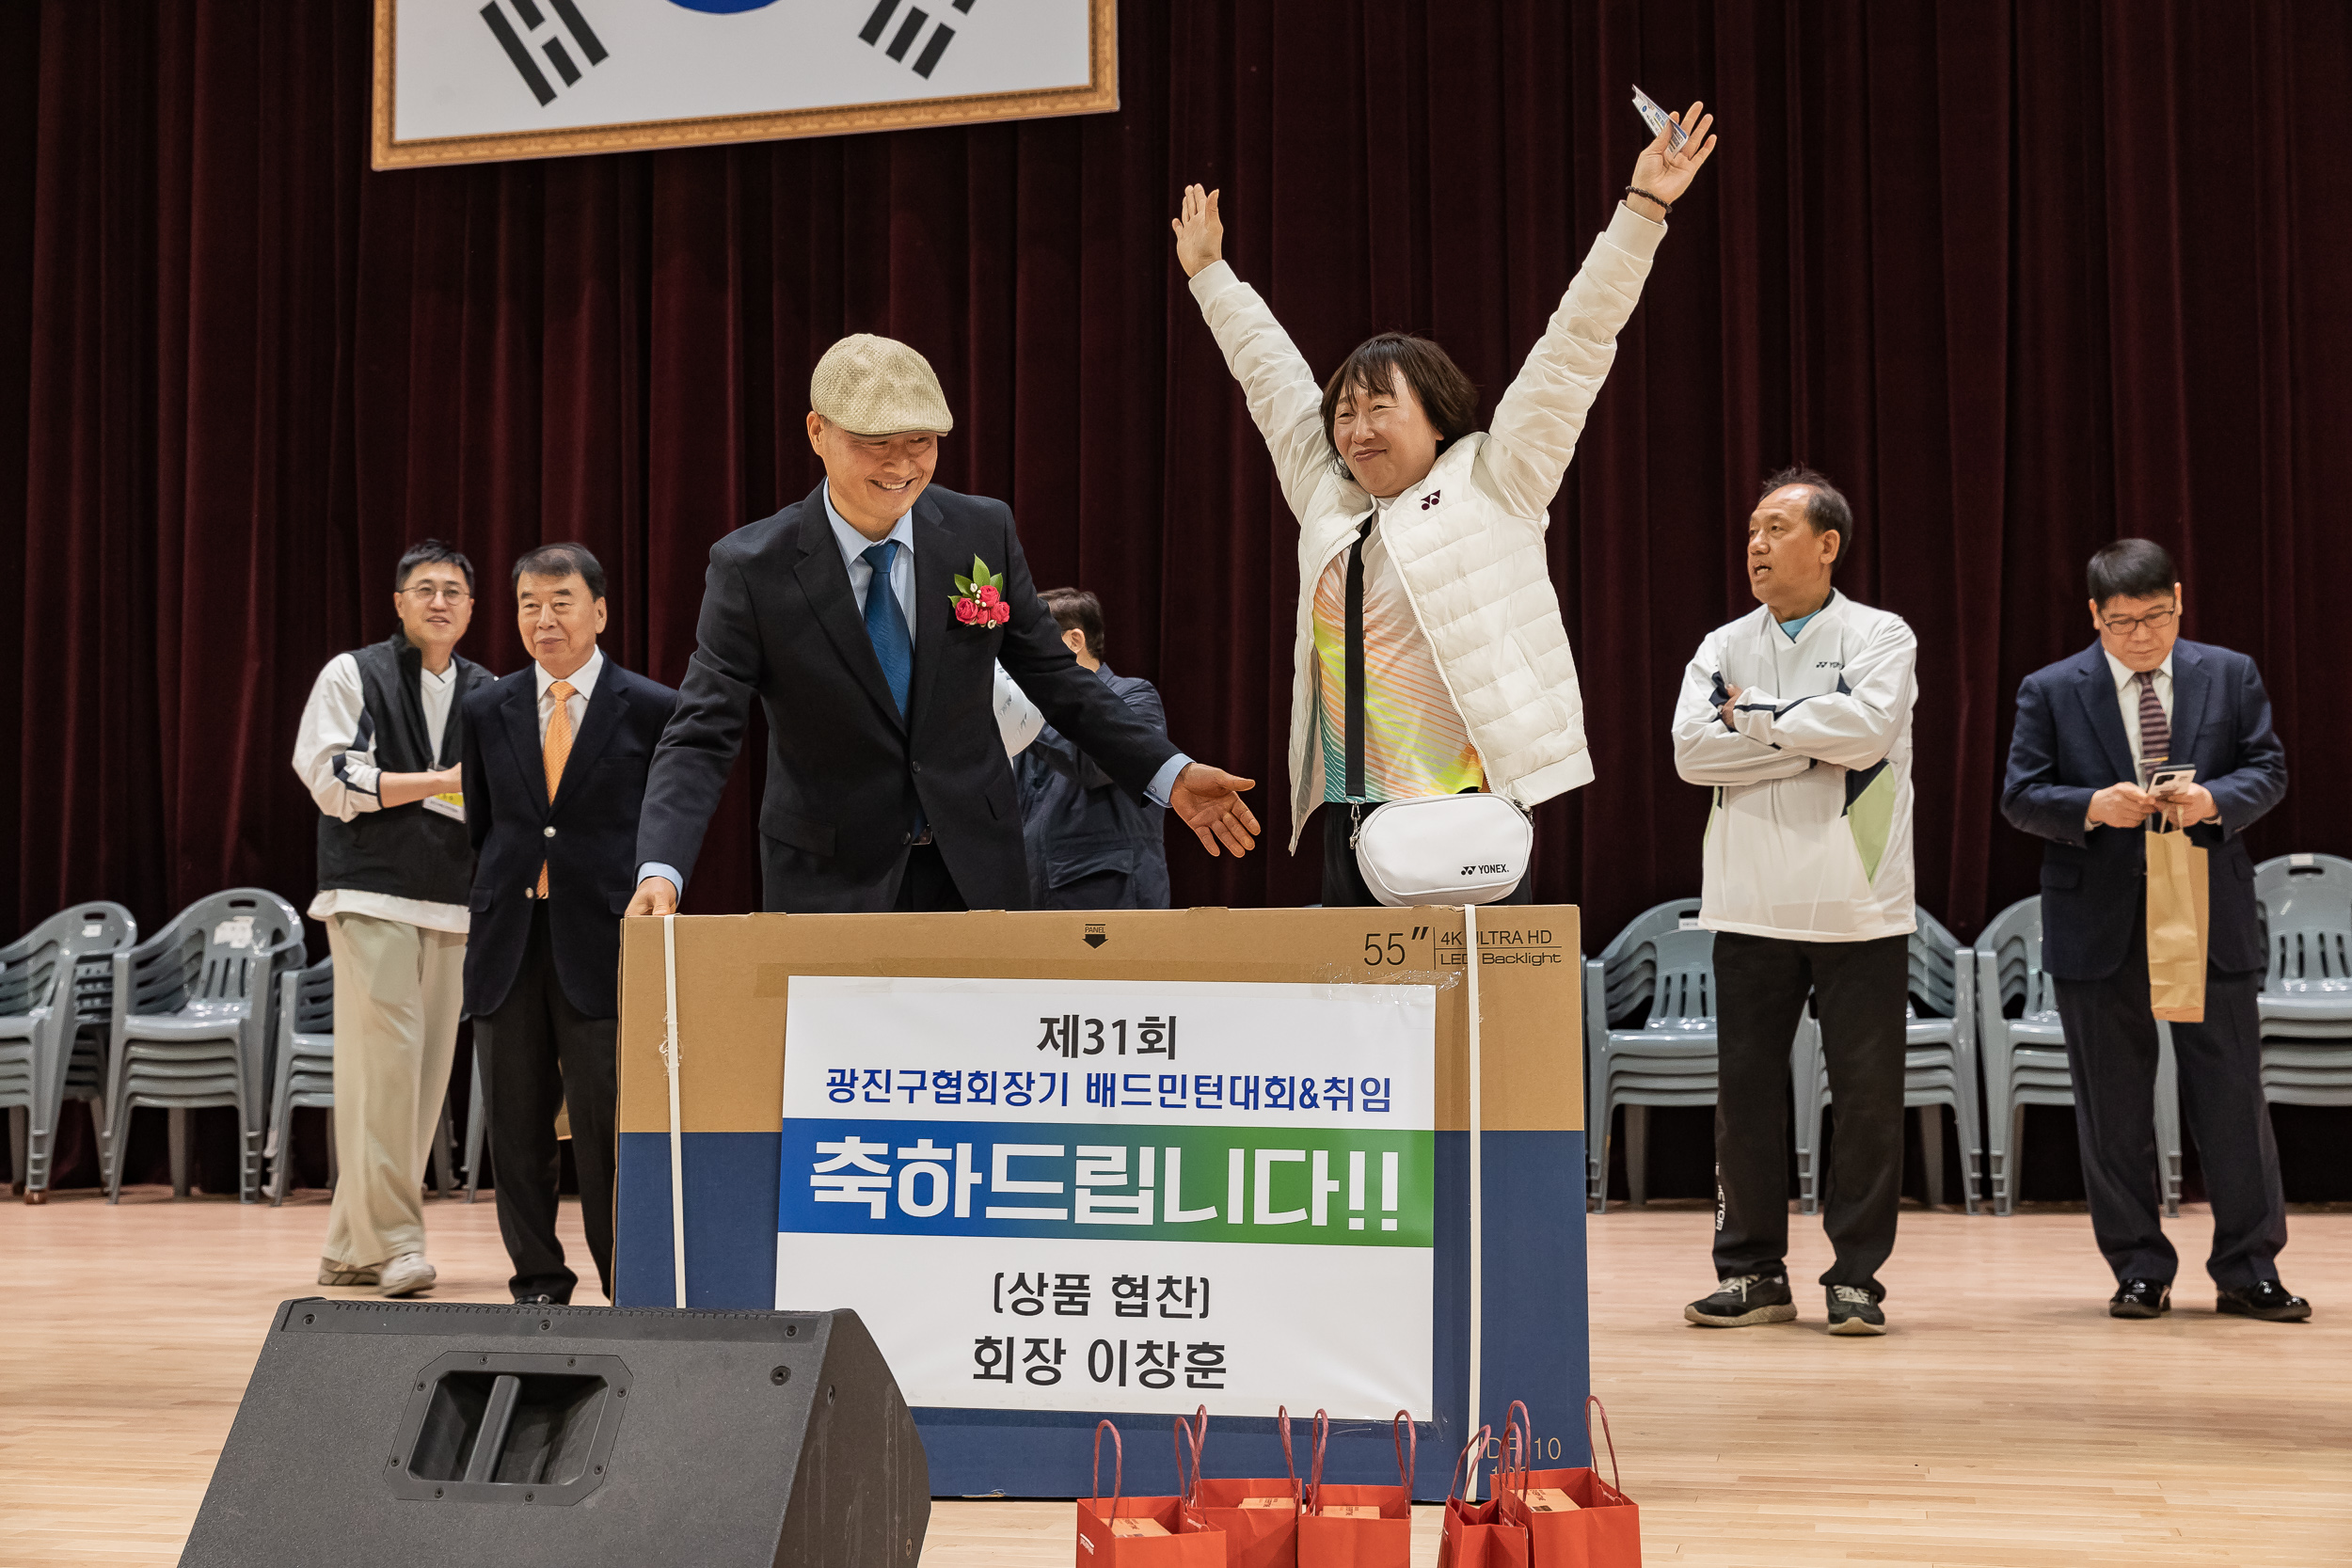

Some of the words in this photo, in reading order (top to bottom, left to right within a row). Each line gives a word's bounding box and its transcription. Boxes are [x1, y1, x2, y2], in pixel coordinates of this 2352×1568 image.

[1440, 931, 1462, 945] 4K
[1475, 930, 1523, 944] LTRA
[1528, 930, 1551, 944] HD
[1482, 952, 1562, 967] Backlight
[1037, 1014, 1177, 1060] 제31회
[826, 1068, 1069, 1107] 광진구협회장기
[1086, 1072, 1391, 1113] 배드민턴대회&취임
[809, 1135, 1400, 1231] 축하드립니다!!
[973, 1335, 1067, 1386] 회장
[1088, 1338, 1227, 1390] 이창훈
[1534, 1437, 1562, 1460] 10
